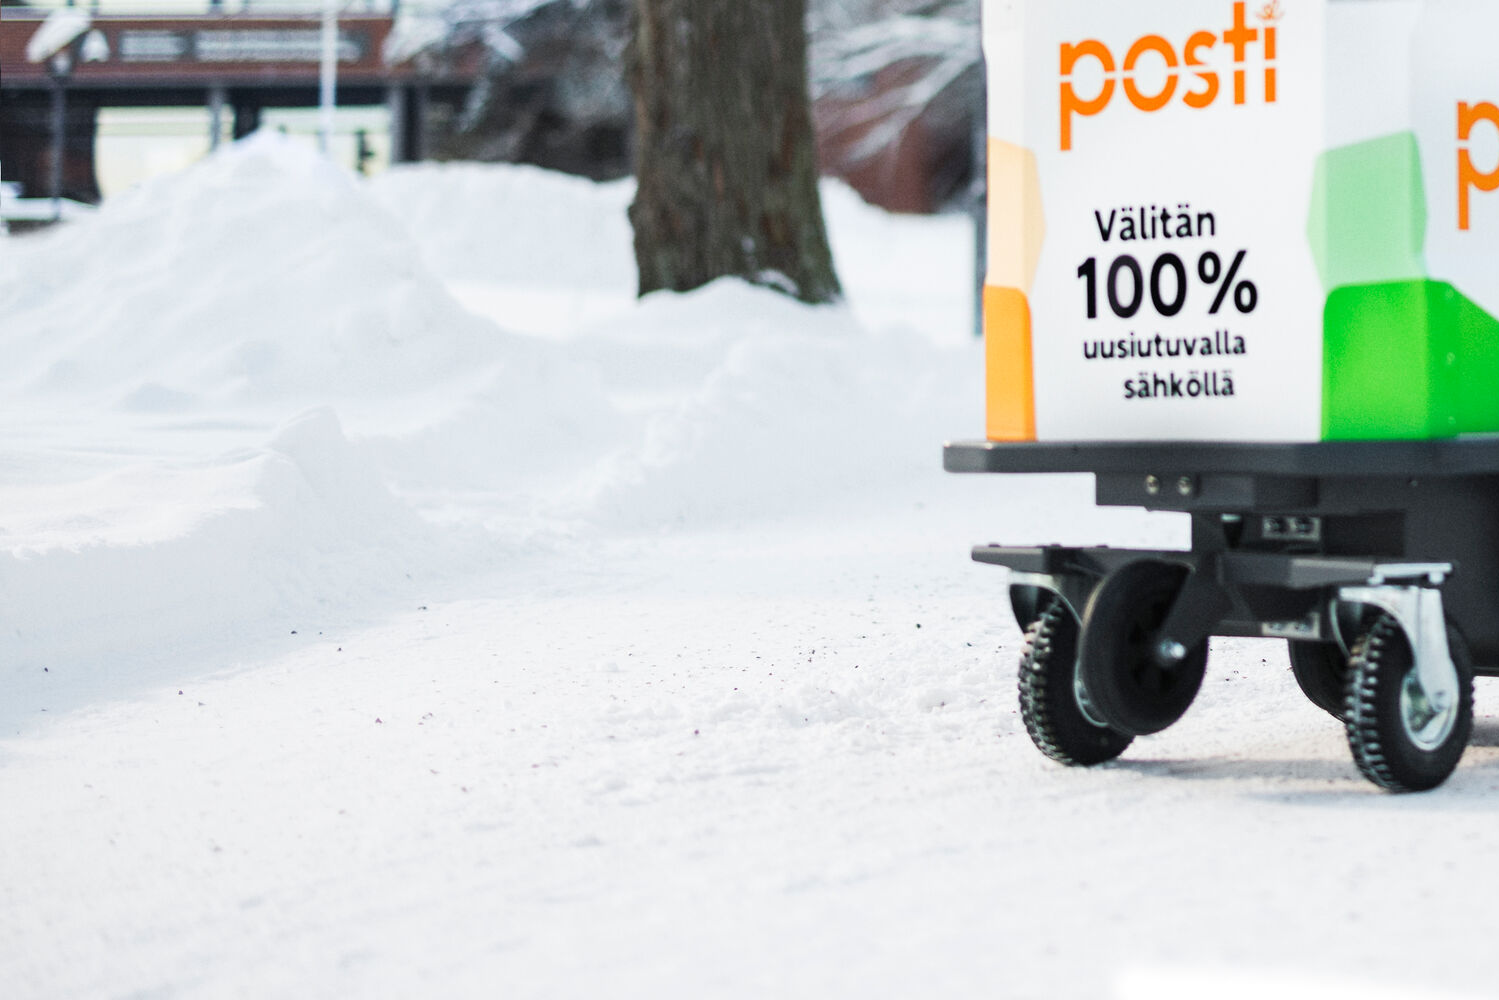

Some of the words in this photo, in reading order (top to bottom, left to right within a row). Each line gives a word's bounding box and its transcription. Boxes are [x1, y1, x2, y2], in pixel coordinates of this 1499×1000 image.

[1059, 0, 1282, 152] posti
[1094, 204, 1216, 242] Välitän
[1076, 249, 1259, 320] 100%
[1083, 331, 1247, 361] uusiutuvalla
[1123, 371, 1236, 400] sähköllä
